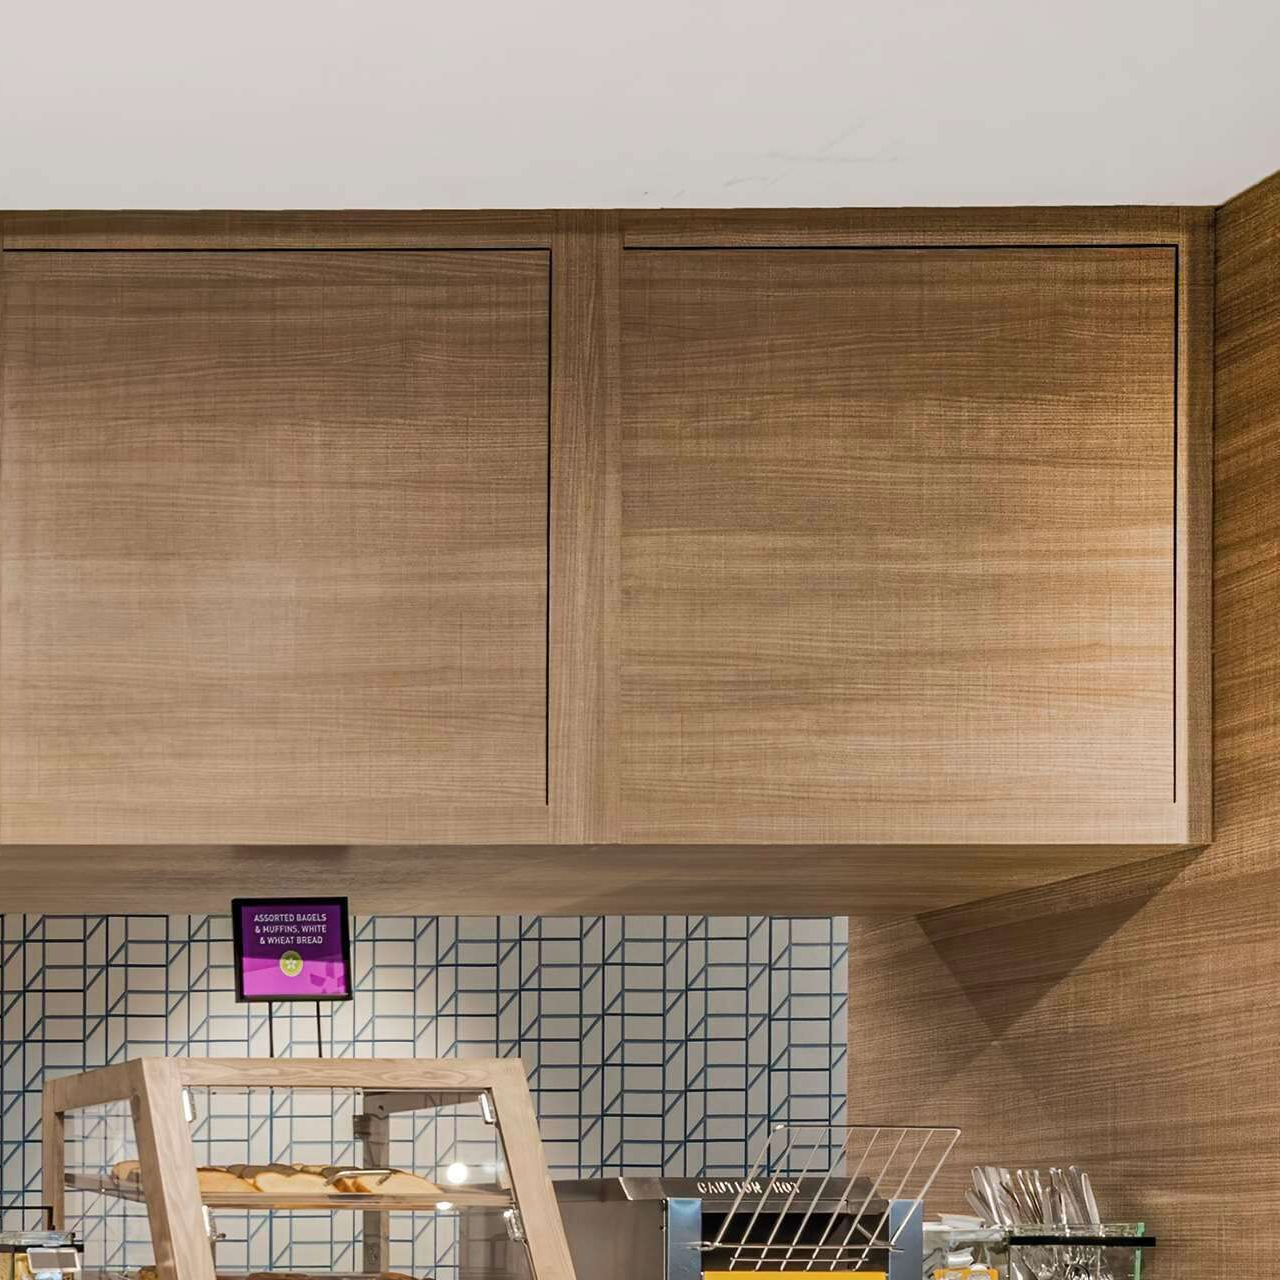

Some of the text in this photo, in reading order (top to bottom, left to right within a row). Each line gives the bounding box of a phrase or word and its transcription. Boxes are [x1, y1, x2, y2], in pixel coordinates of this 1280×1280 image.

[253, 913, 327, 922] ASSORTED BAGELS
[254, 924, 327, 934] & MUFFINS, WHITE
[259, 936, 323, 945] & WHEAT BREAD
[697, 1181, 800, 1194] CAUTION HOT
